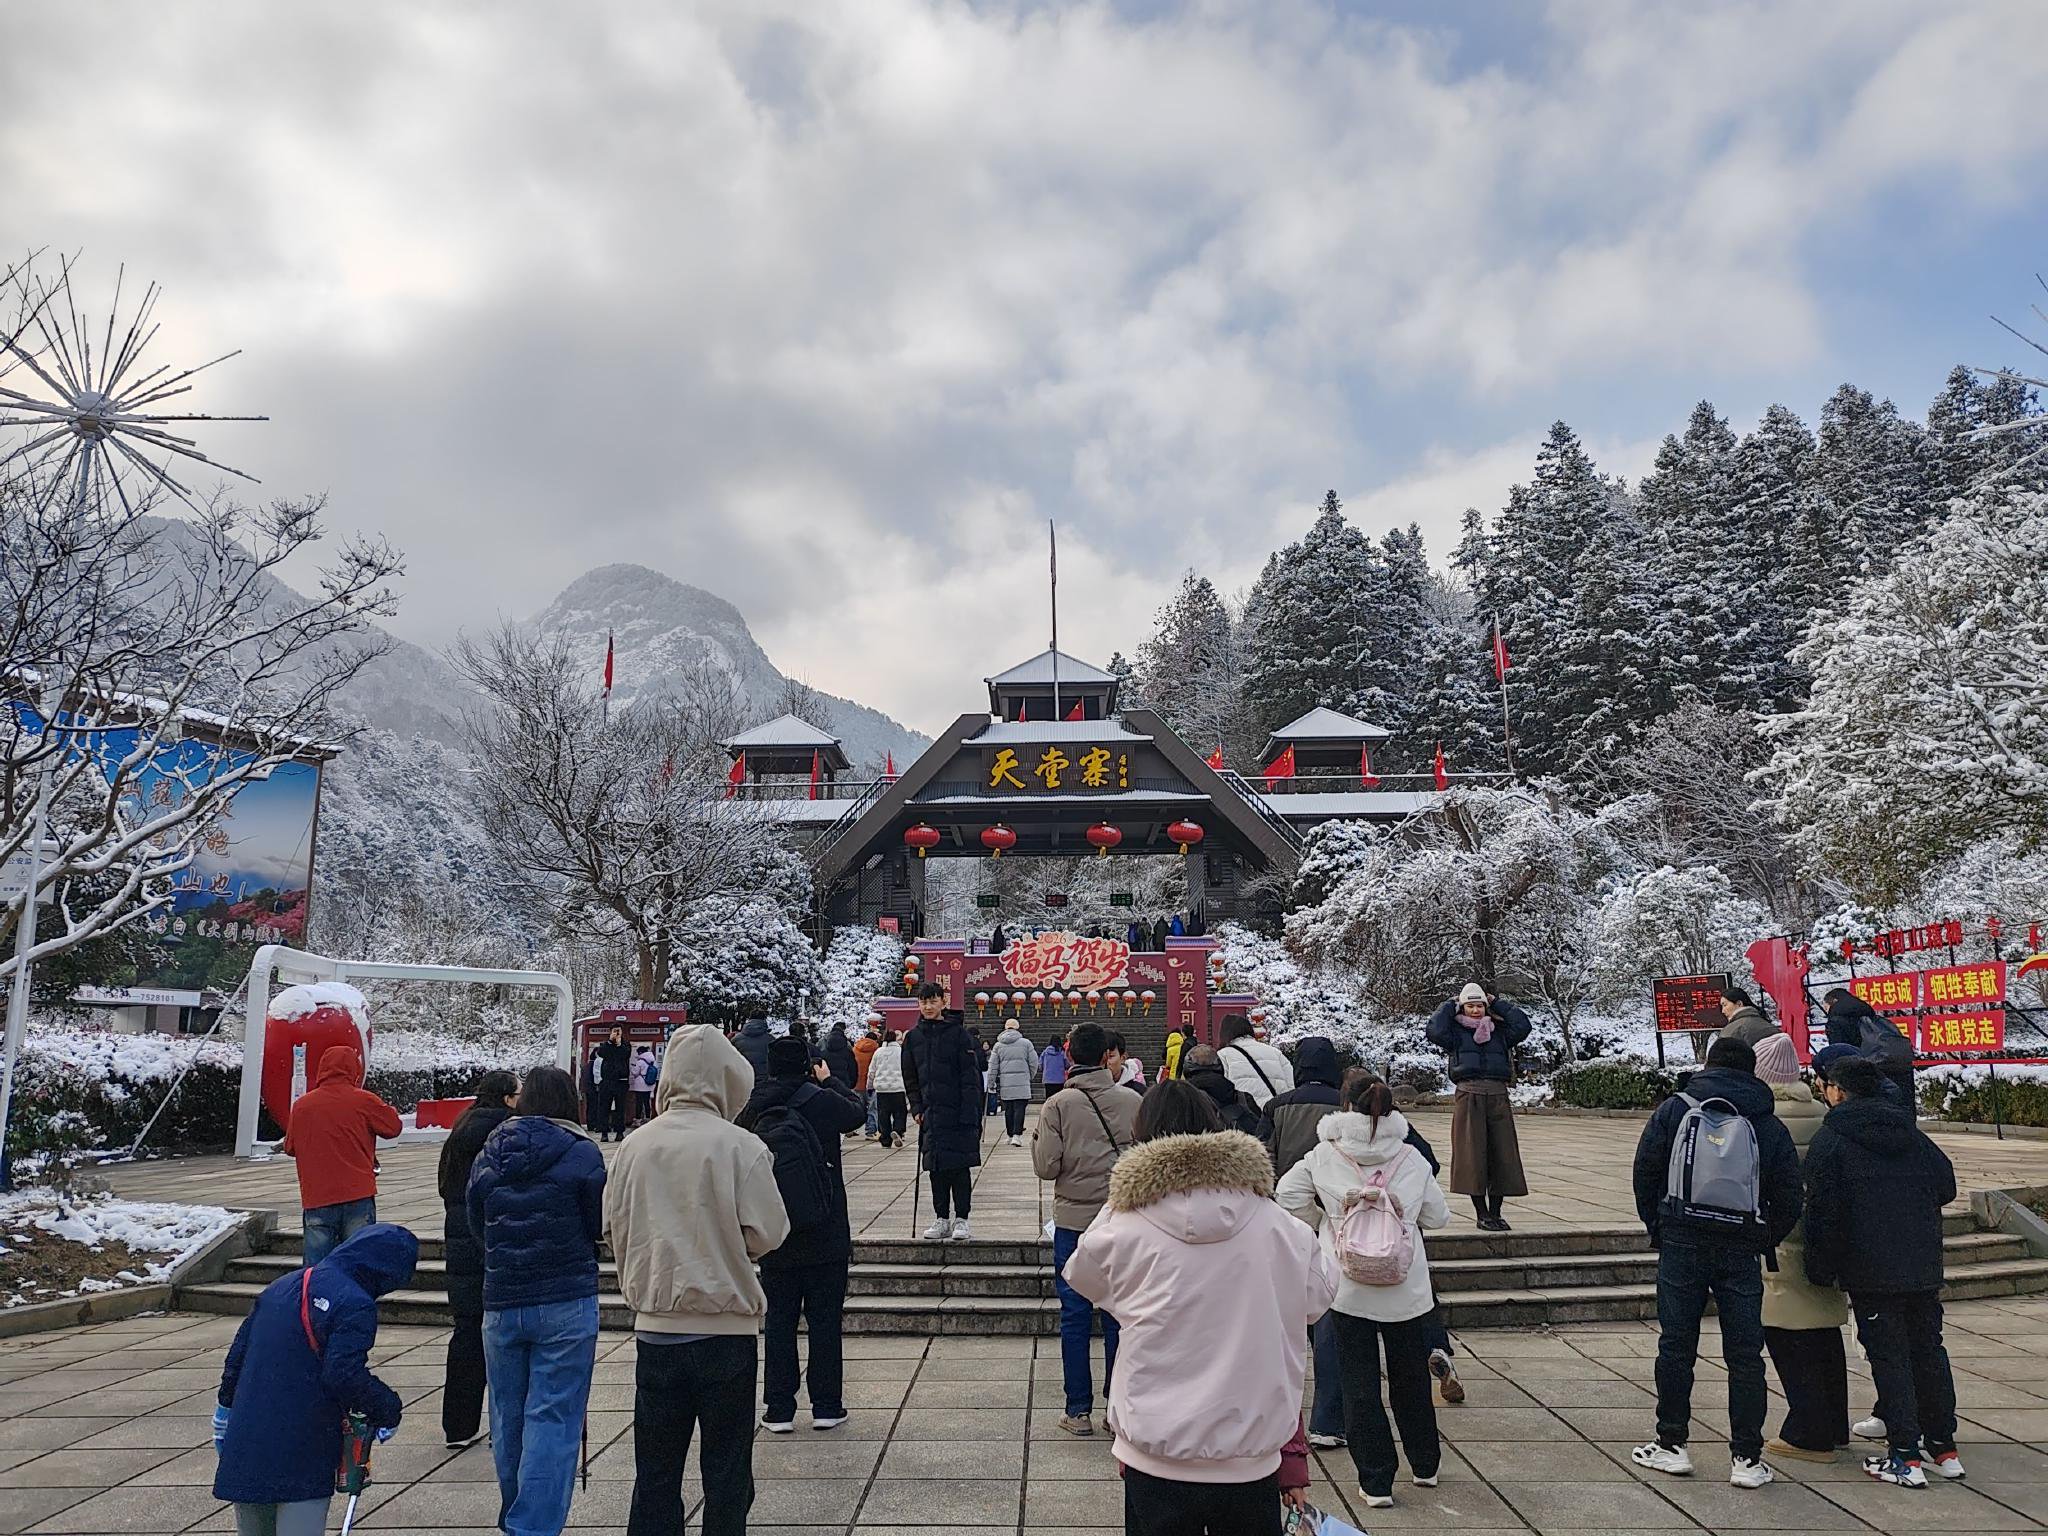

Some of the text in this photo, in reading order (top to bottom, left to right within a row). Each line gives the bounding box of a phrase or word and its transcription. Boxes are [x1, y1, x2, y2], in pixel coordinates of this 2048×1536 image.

[989, 746, 1111, 789] 天堂寨
[1001, 939, 1129, 986] 福马贺岁
[1855, 977, 1913, 1006] 坚贞忠诚
[1930, 968, 1999, 1001] 牺牲奉献
[1178, 971, 1197, 1038] 势不可
[1930, 1017, 1997, 1047] 永跟党走
